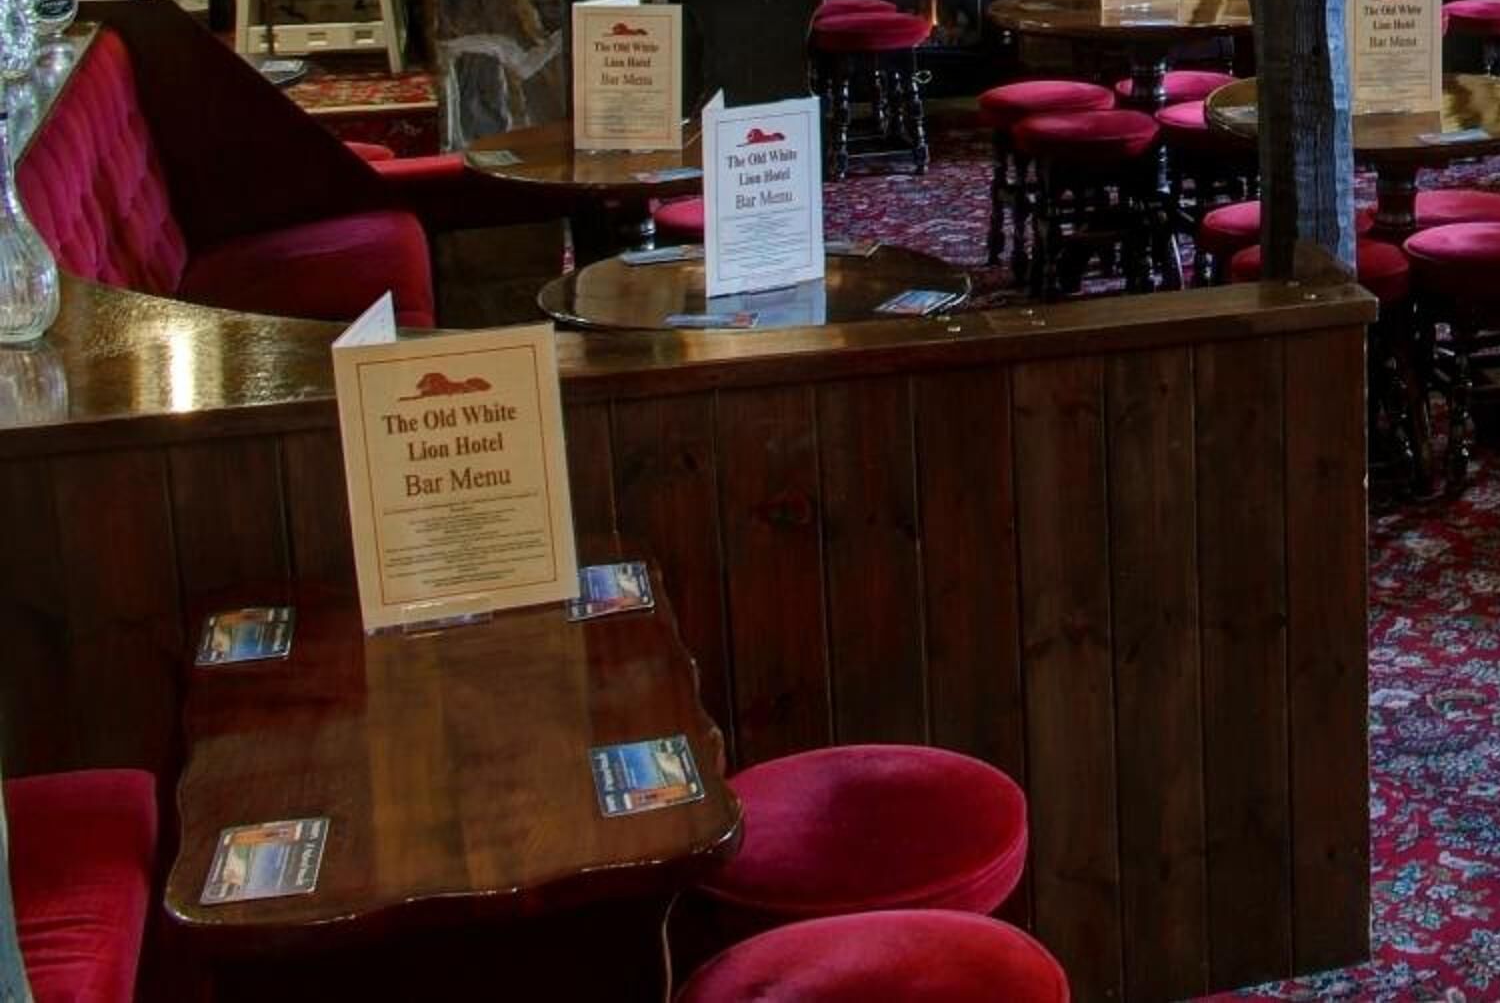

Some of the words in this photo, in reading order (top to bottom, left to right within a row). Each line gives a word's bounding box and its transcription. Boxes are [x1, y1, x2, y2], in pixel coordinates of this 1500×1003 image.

[594, 41, 611, 52] The
[613, 42, 630, 53] Old
[631, 42, 659, 53] White
[604, 56, 625, 68] Lion
[627, 56, 651, 68] Hotel
[601, 72, 619, 86] Bar
[623, 72, 653, 86] Menu
[726, 154, 745, 169] The
[747, 152, 767, 166] Old
[769, 149, 798, 163] White
[739, 172, 762, 186] Lion
[764, 166, 791, 182] Hotel
[735, 193, 757, 210] Bar
[760, 190, 793, 206] Menu
[382, 413, 418, 435] The
[423, 408, 457, 430] Old
[461, 403, 518, 426] White
[408, 440, 449, 462] Lion
[455, 432, 503, 456] Hotel
[405, 474, 444, 497] Bar
[449, 466, 512, 492] Menu
